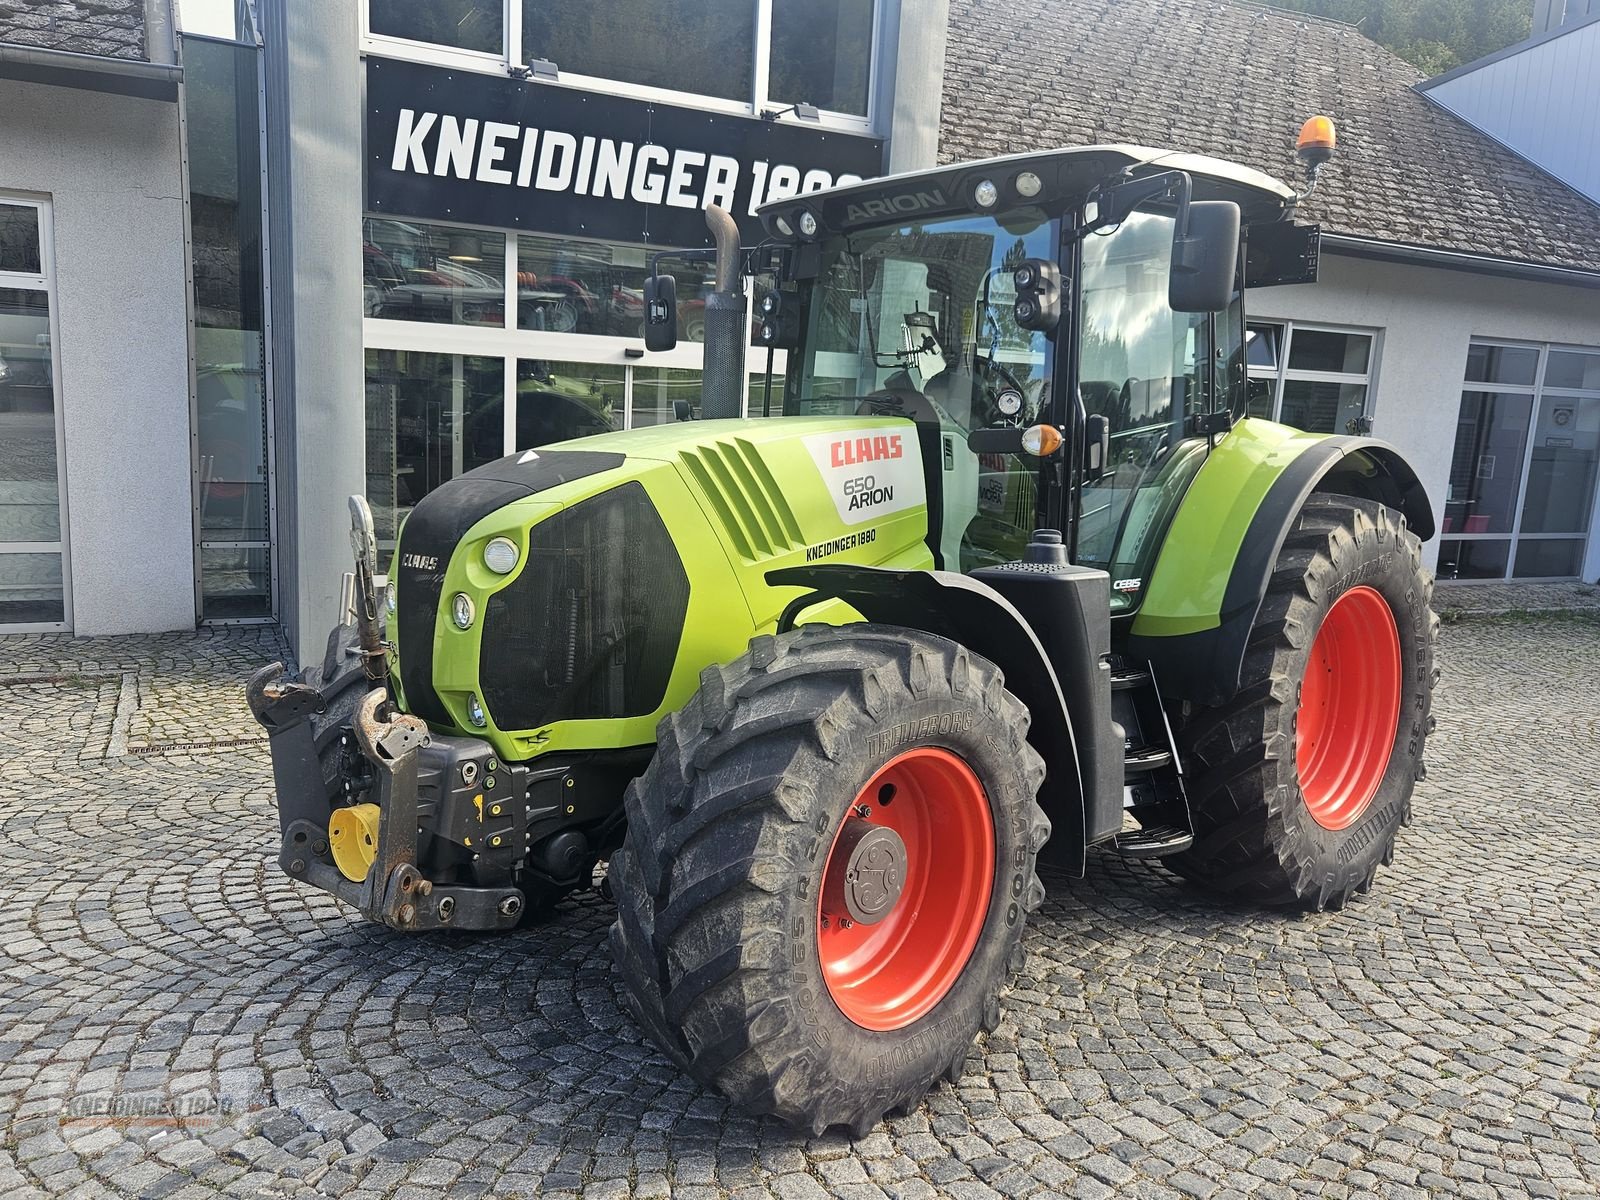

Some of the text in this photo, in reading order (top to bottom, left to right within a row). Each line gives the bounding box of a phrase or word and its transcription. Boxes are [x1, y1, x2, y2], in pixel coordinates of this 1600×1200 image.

[391, 108, 740, 213] KNEIDINGER
[847, 189, 947, 221] ARION
[830, 435, 903, 468] CLAAS
[843, 475, 876, 496] 650
[848, 485, 894, 511] ARION
[402, 553, 438, 570] CLAAS
[806, 528, 877, 563] KNEIDINGER 1880
[1113, 577, 1142, 590] CEBIS
[865, 708, 975, 759] TRELLEBORG
